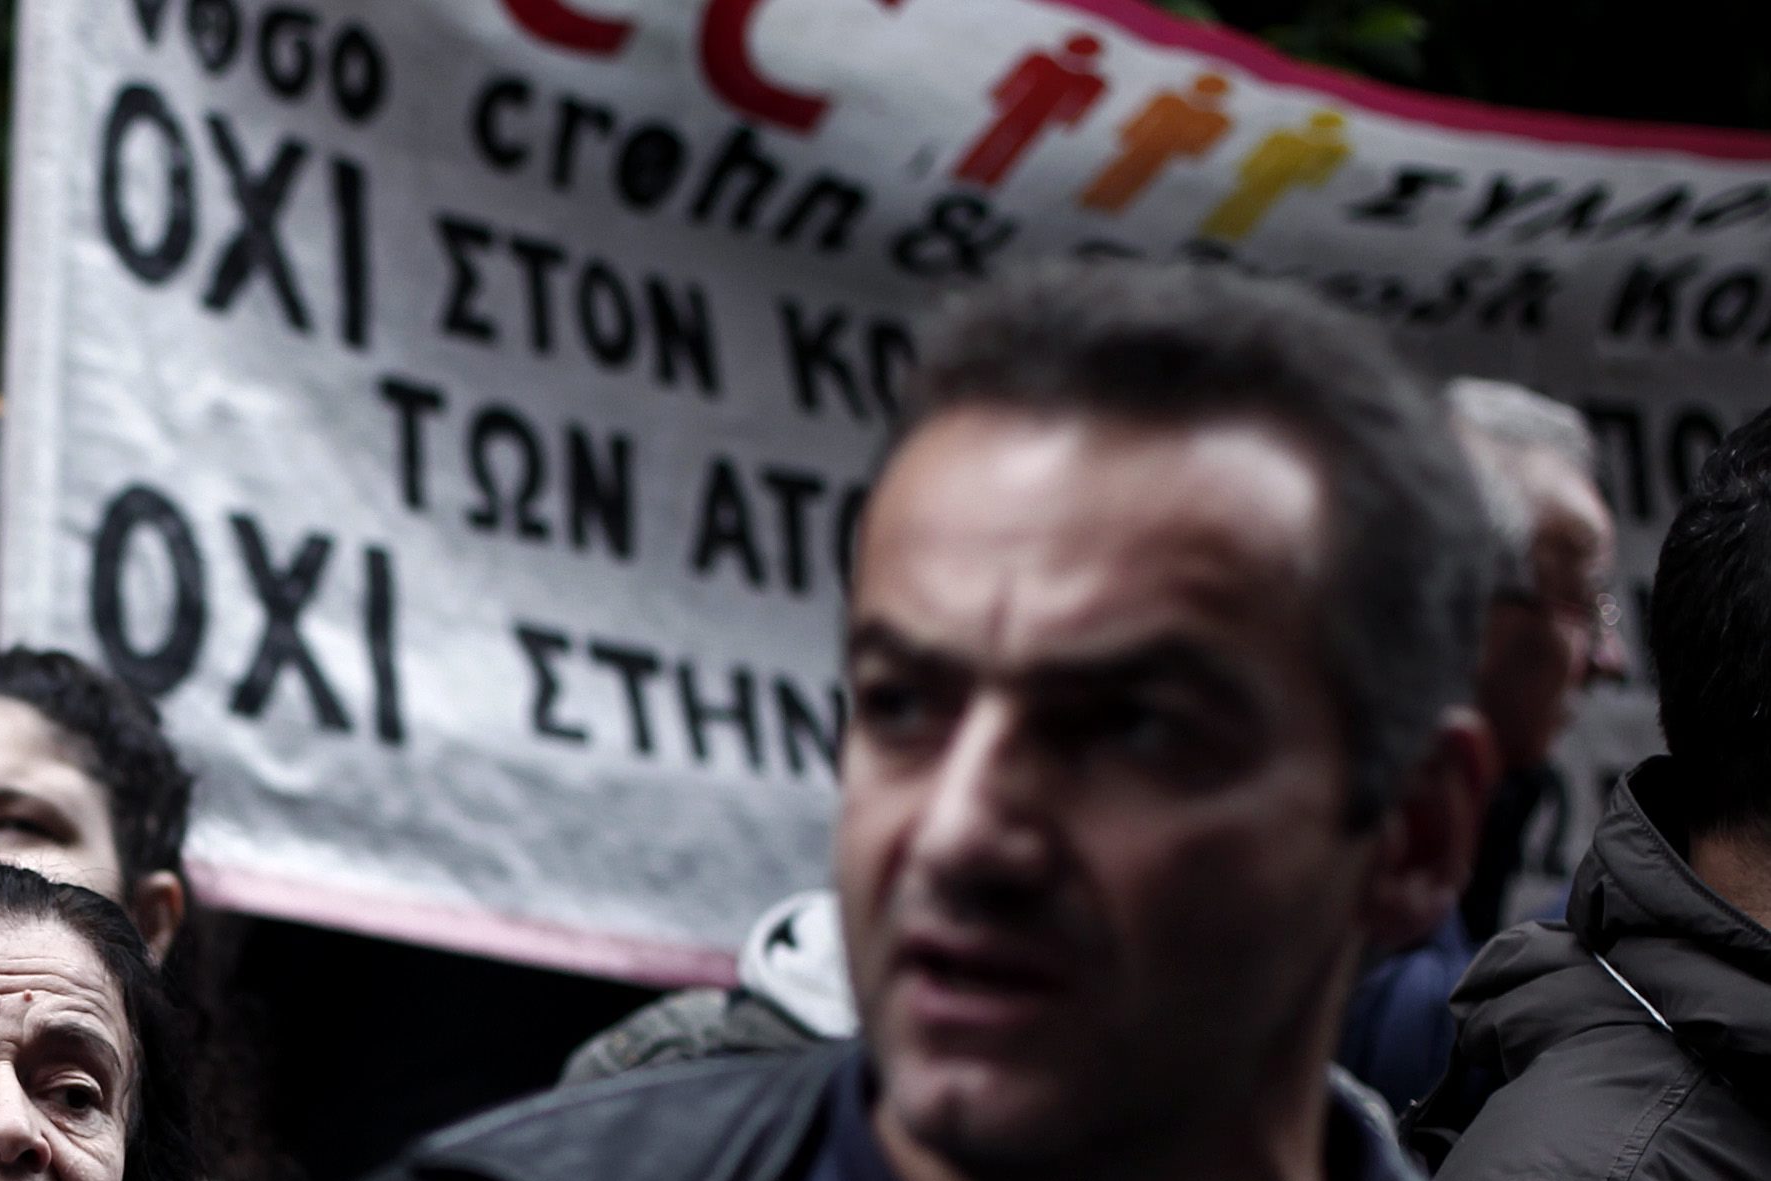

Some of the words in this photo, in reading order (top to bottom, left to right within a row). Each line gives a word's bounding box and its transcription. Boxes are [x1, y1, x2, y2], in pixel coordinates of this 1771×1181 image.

[100, 83, 370, 348] ΟΧΙ
[438, 213, 720, 394] ΣΤΟΝ
[473, 76, 866, 252] crohn
[379, 377, 636, 560] ΤΩΝ
[91, 482, 404, 746] ΟΧΙ
[514, 622, 844, 782] ΣΤΗΝ
